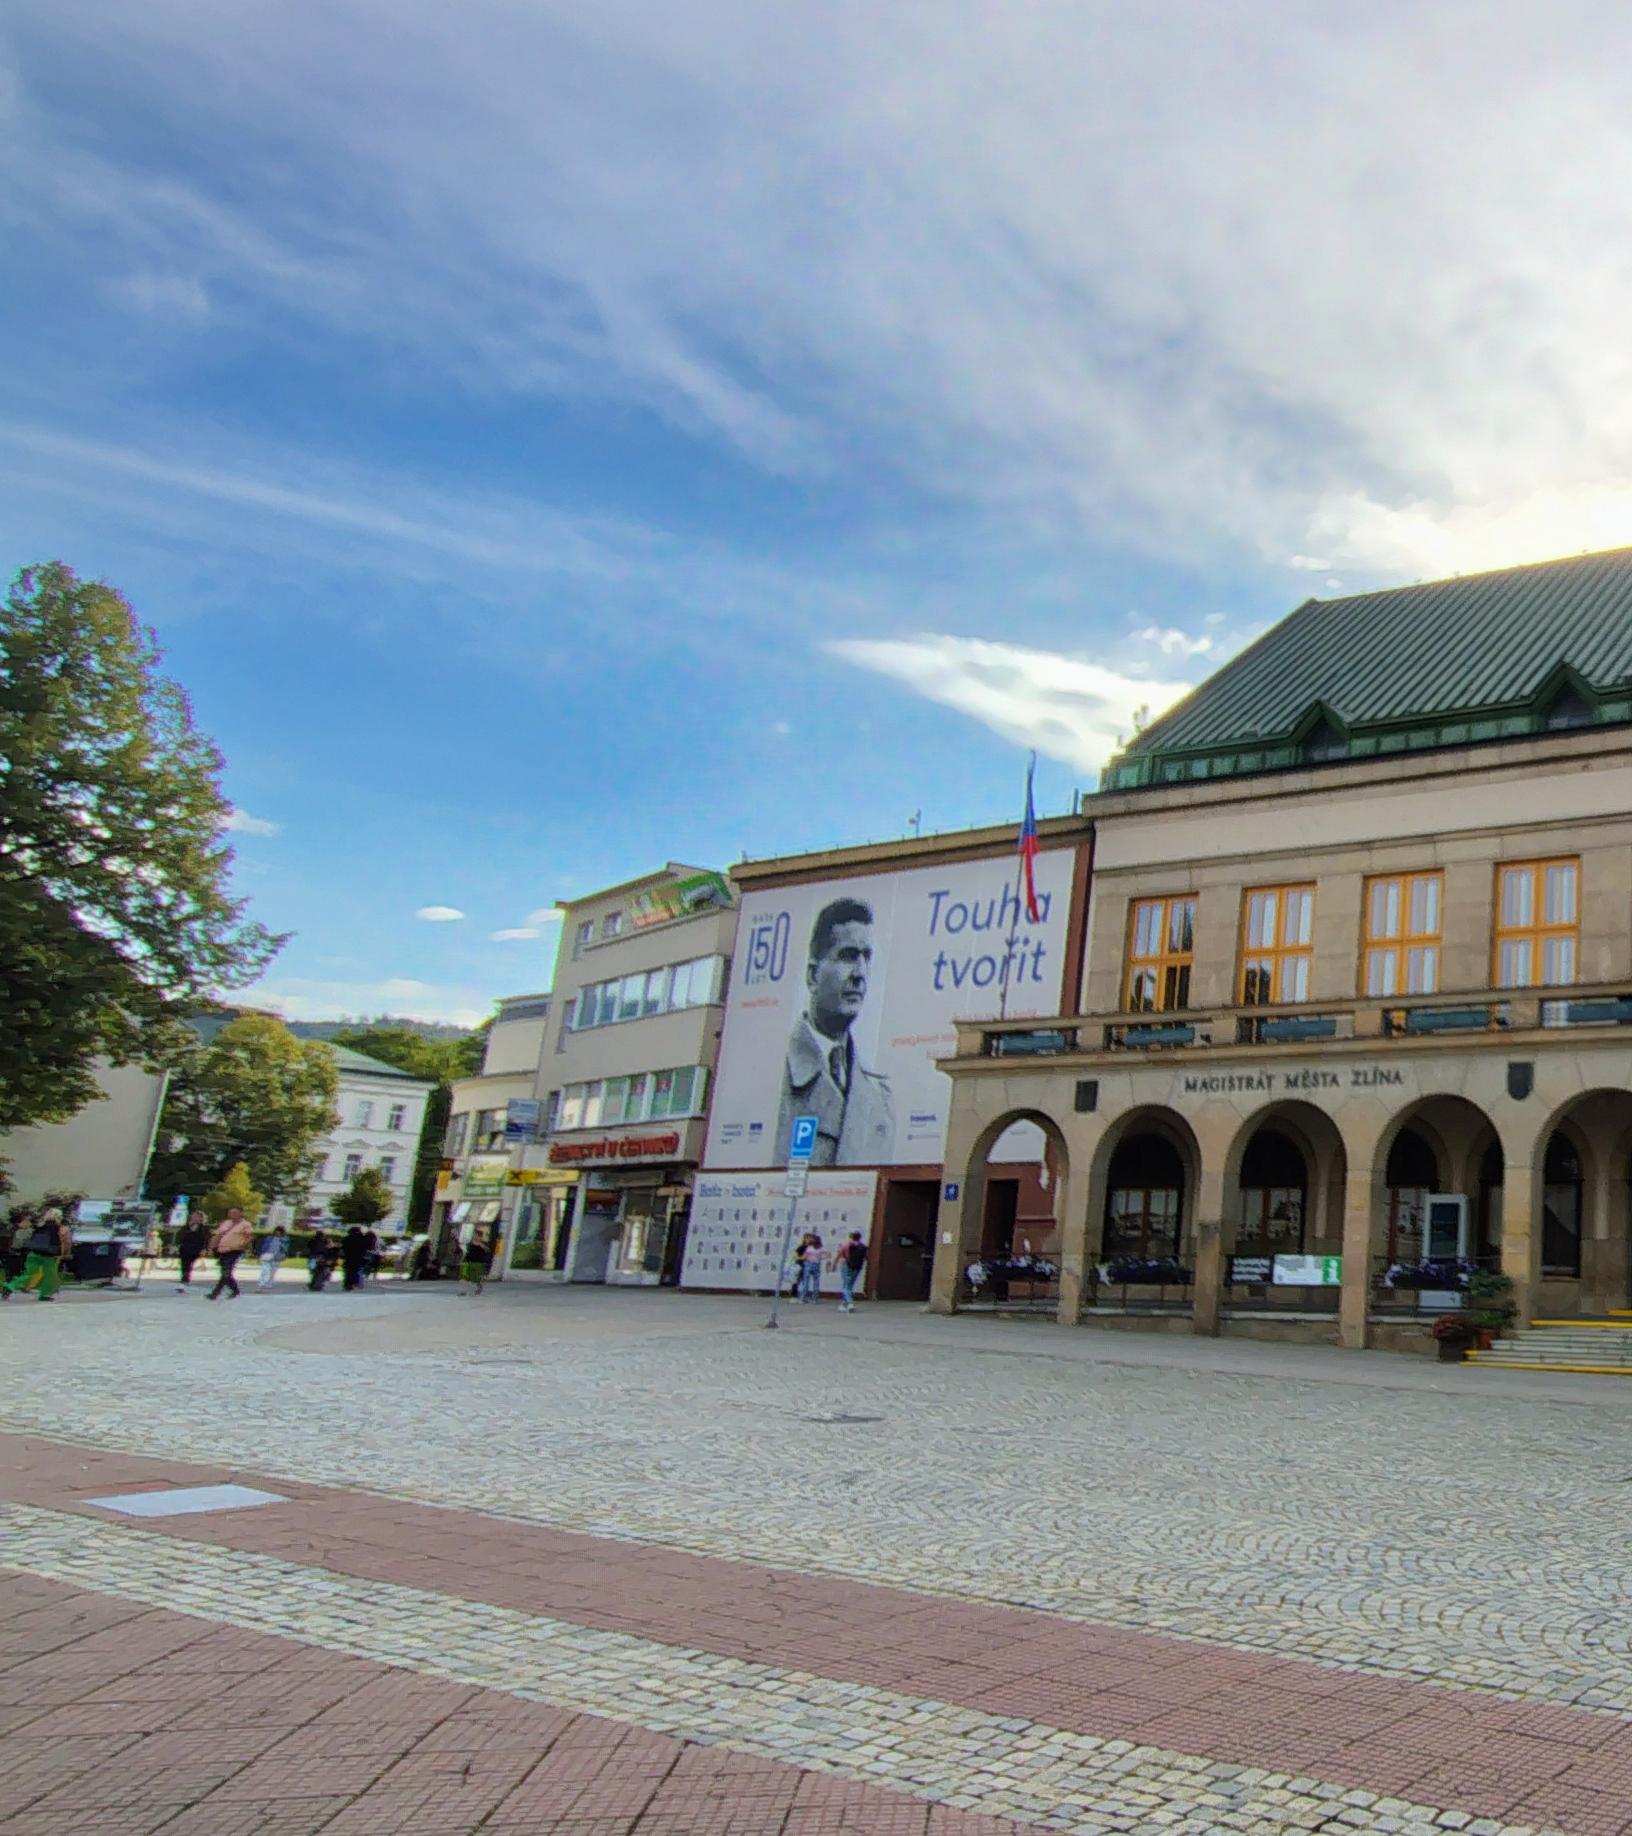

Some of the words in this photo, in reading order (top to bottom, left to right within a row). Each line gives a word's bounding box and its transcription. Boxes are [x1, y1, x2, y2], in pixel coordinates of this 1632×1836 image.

[928, 882, 1052, 935] Touha
[744, 911, 791, 985] 150
[933, 936, 1047, 991] tvořit
[1184, 1072, 1275, 1094] MAGISTRÁT
[1284, 1068, 1340, 1089] MĚSTA
[1350, 1066, 1404, 1087] ZLÍNA
[796, 1121, 812, 1146] P
